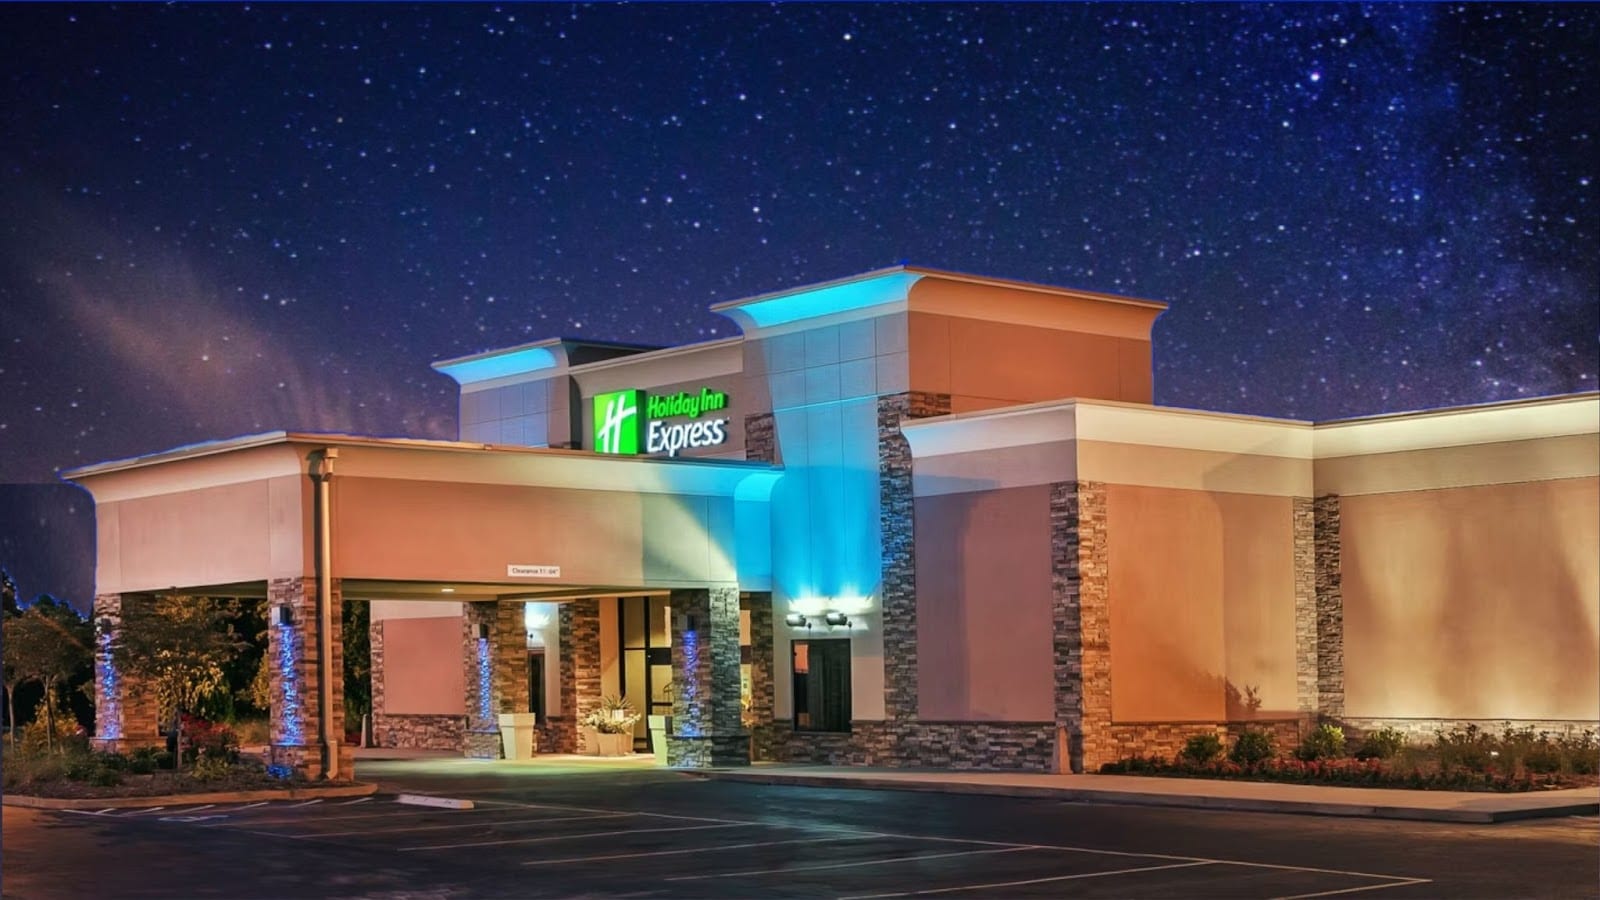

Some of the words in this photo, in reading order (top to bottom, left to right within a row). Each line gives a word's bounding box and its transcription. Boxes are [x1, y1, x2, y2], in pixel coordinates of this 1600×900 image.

[647, 391, 701, 418] Holiday
[701, 387, 724, 411] Inn
[647, 418, 725, 457] Express
